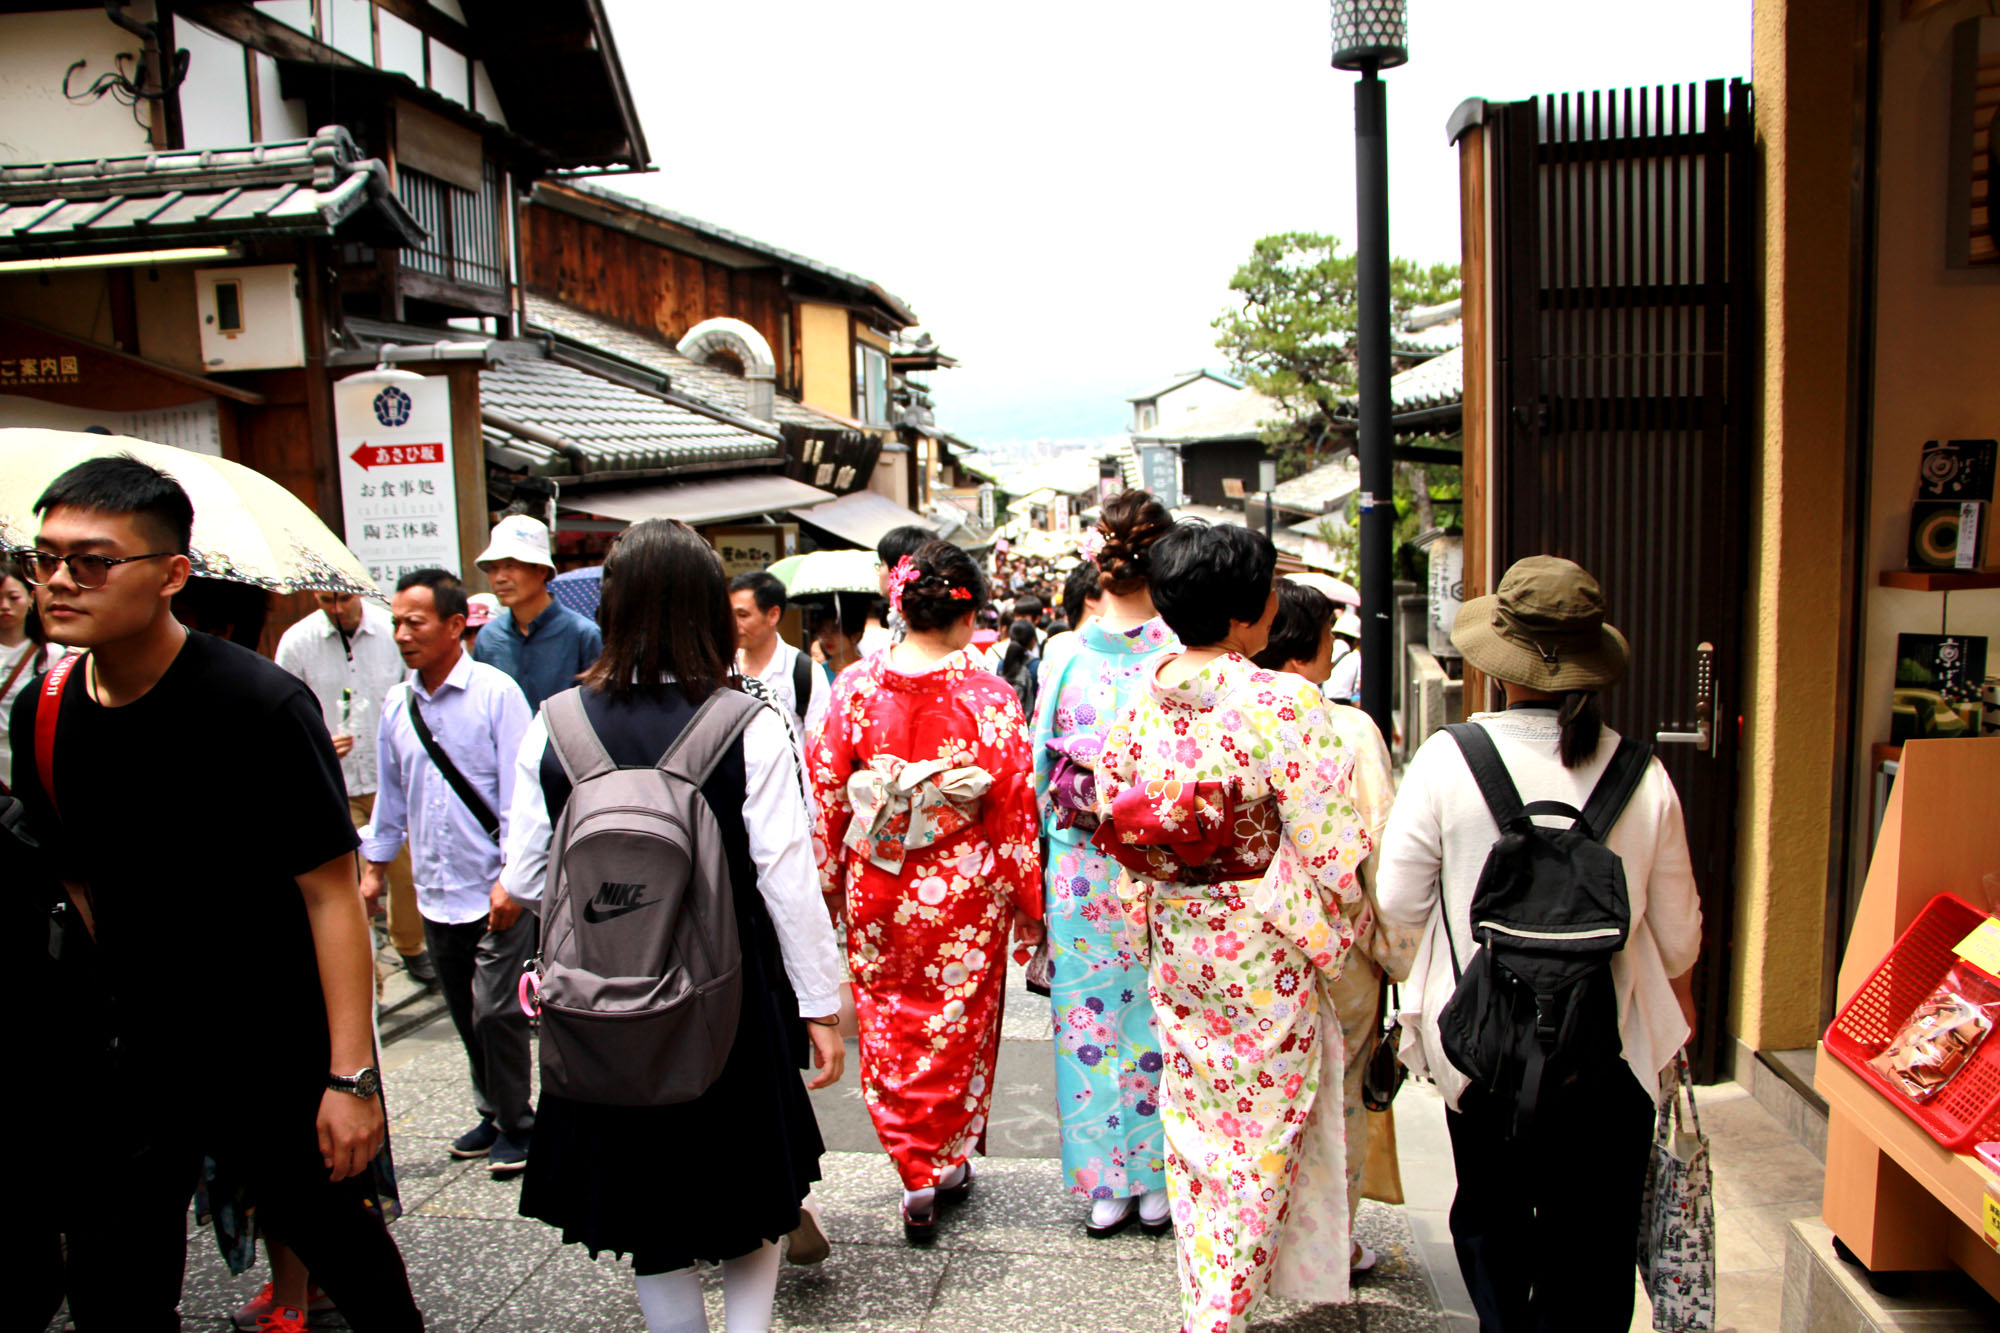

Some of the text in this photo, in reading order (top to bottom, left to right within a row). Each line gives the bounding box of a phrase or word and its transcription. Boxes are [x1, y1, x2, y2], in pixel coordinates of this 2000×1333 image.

[376, 445, 436, 464] あさひ坂
[360, 479, 435, 498] お食事処
[363, 521, 439, 541] 陶芸体験
[594, 882, 647, 906] NIKE
